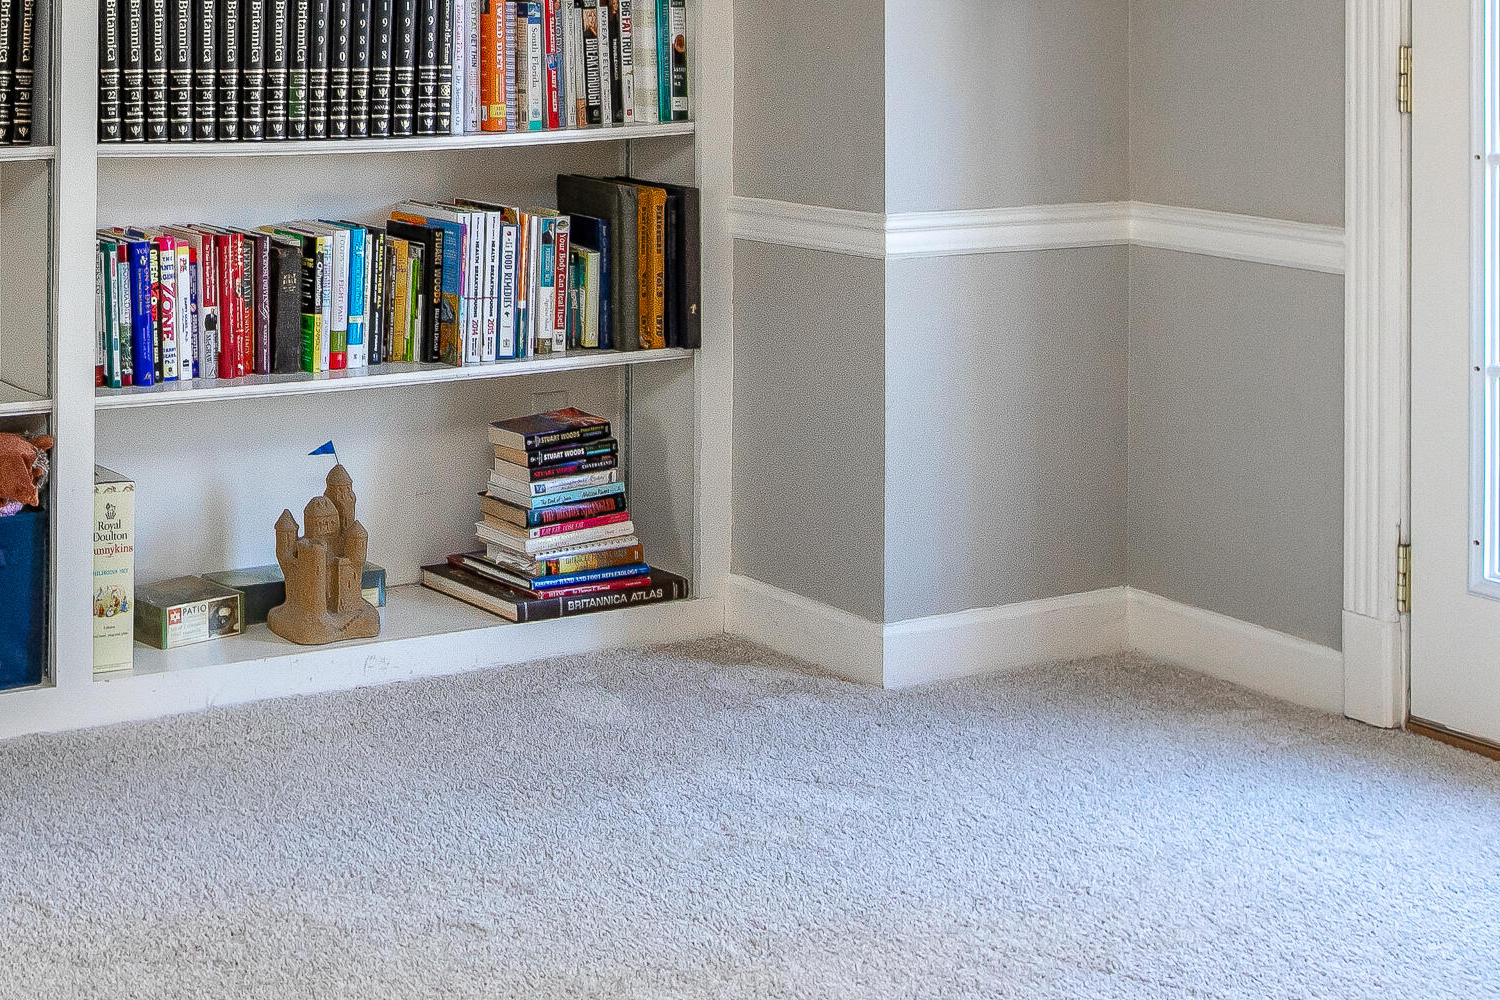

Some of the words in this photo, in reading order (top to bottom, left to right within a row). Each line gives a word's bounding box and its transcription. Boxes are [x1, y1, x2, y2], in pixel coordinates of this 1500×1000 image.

[621, 1, 630, 16] BIG
[179, 0, 188, 63] Britannica
[622, 18, 632, 35] FAT
[531, 27, 540, 53] South
[622, 36, 632, 66] TRUTH
[532, 56, 540, 88] Florida
[586, 38, 600, 105] BREAKTHROUGH
[21, 92, 30, 101] 20
[107, 91, 116, 100] 22
[558, 234, 566, 252] Your
[150, 249, 158, 283] OMEGA
[504, 250, 513, 270] FOOD
[558, 253, 566, 272] Body
[433, 269, 441, 304] WOODS
[503, 273, 513, 308] REMEDIES
[151, 289, 159, 321] ZONE
[558, 290, 566, 307] Heal
[161, 282, 176, 342] ZONE
[557, 309, 565, 328] Itself
[487, 318, 495, 335] 2015
[540, 435, 559, 444] STUART
[561, 431, 580, 440] WOODS
[544, 452, 563, 460] STUART
[565, 448, 584, 457] WOODS
[98, 519, 122, 532] Royal
[93, 532, 128, 542] Doulton
[94, 544, 133, 557] unnykins
[568, 594, 628, 611] BRITANNICA
[631, 589, 663, 601] ATLAS
[183, 605, 206, 616] PATIO
